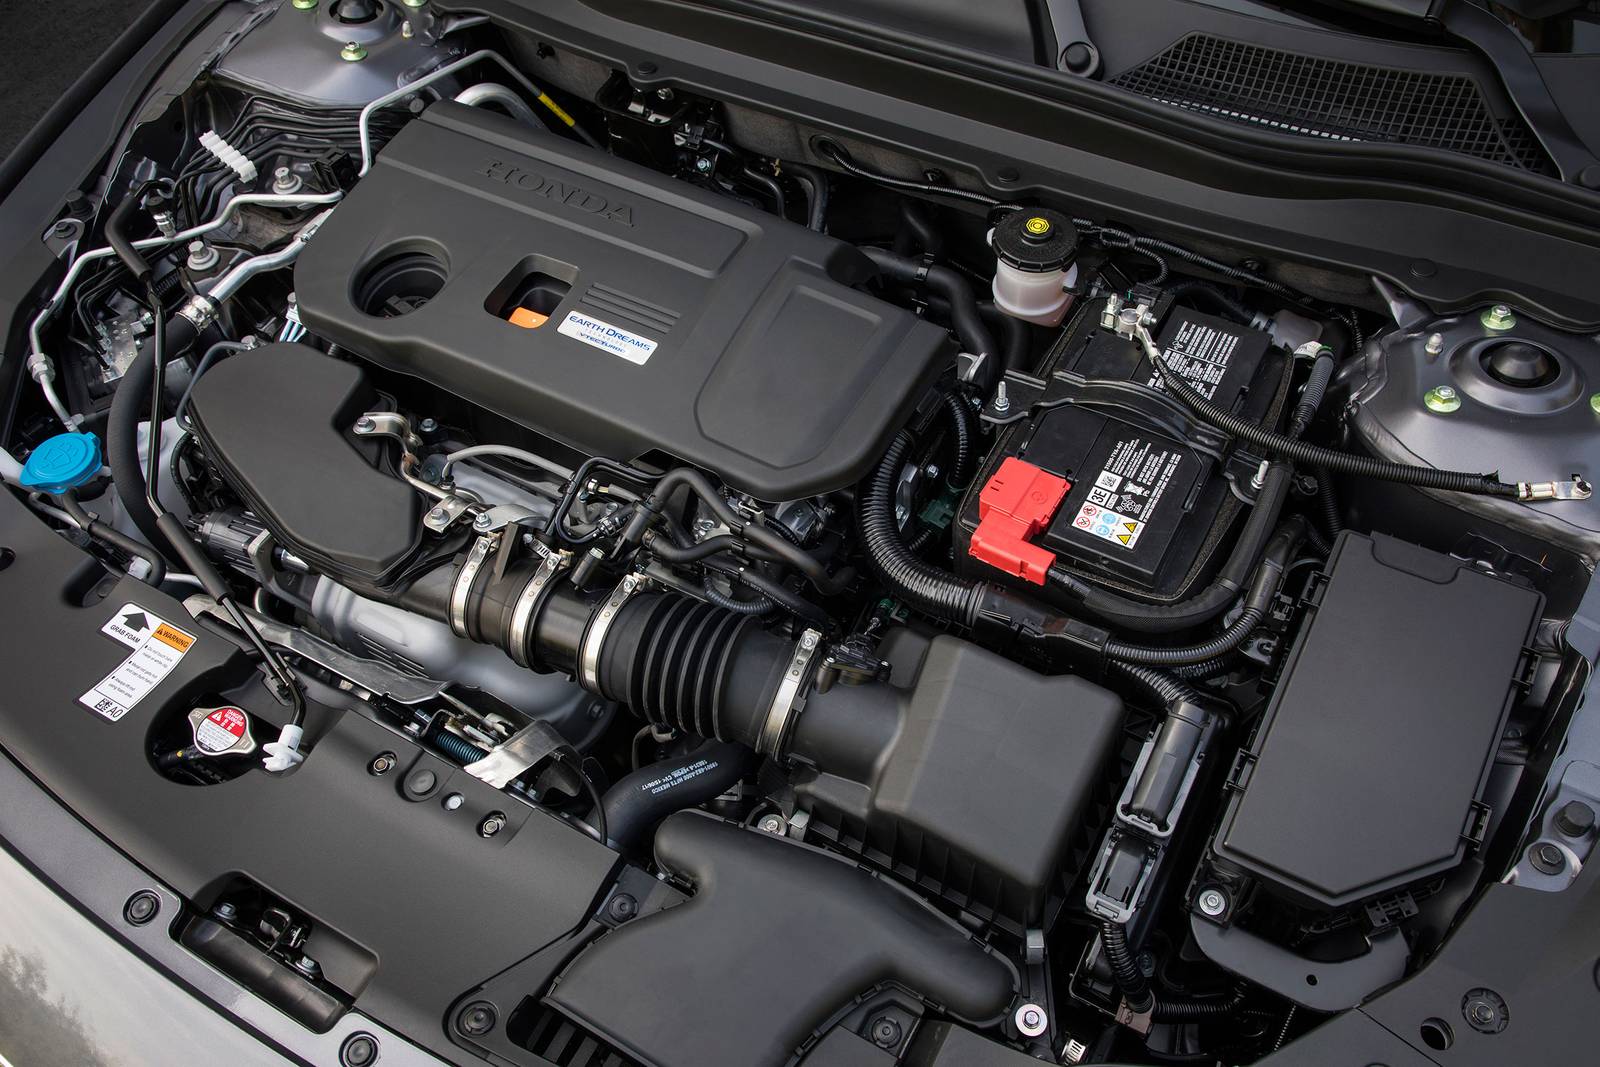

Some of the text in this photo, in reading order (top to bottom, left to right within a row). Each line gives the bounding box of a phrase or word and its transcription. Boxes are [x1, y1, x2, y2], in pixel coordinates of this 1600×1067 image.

[475, 159, 636, 228] HONDA
[569, 315, 652, 351] EARTH DREAMS
[1091, 489, 1107, 503] 3E
[110, 624, 142, 644] GRAB FOAM
[162, 628, 190, 648] WARNING
[106, 706, 124, 718] A0
